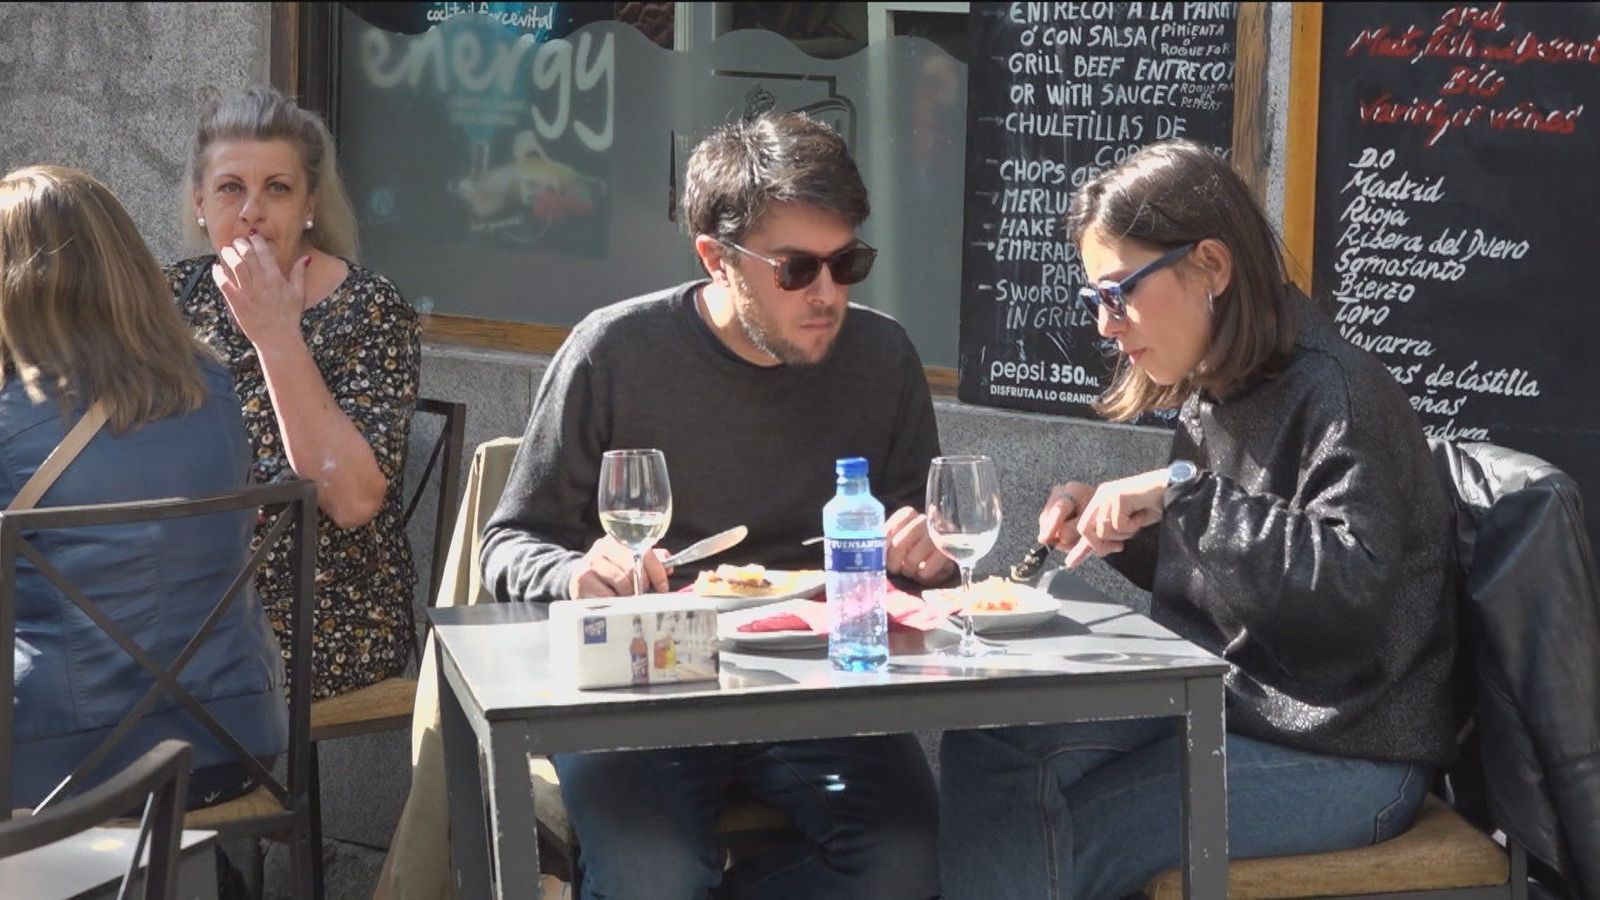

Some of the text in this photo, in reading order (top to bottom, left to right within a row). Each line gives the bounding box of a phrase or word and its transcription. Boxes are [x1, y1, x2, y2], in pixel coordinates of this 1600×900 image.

[1127, 2, 1143, 19] A
[1150, 2, 1174, 20] LA
[1042, 26, 1082, 46] CON
[1008, 50, 1063, 75] GRILL
[1074, 55, 1125, 78] BEEF
[361, 26, 615, 152] energy
[1010, 83, 1035, 105] OR
[1046, 80, 1093, 105] WITH
[1004, 110, 1187, 141] CHULETILLAS DE
[999, 159, 1067, 185] CHOPS
[1340, 170, 1446, 203] Madrid
[1340, 195, 1411, 226] Rioja
[1000, 217, 1057, 238] HAKE
[995, 238, 1081, 262] EMPERAD
[1336, 224, 1530, 262] Ribera del Duero
[995, 278, 1069, 304] SWORD
[1332, 273, 1416, 303] Bierzo
[1033, 303, 1092, 329] GRILL
[1334, 297, 1391, 326] Toro
[990, 360, 1045, 385] pepsi
[1425, 362, 1455, 388] de
[1455, 360, 1541, 398] Castilla
[990, 384, 1036, 399] DISFRUTA
[1035, 389, 1044, 400] A
[1044, 390, 1058, 401] LO
